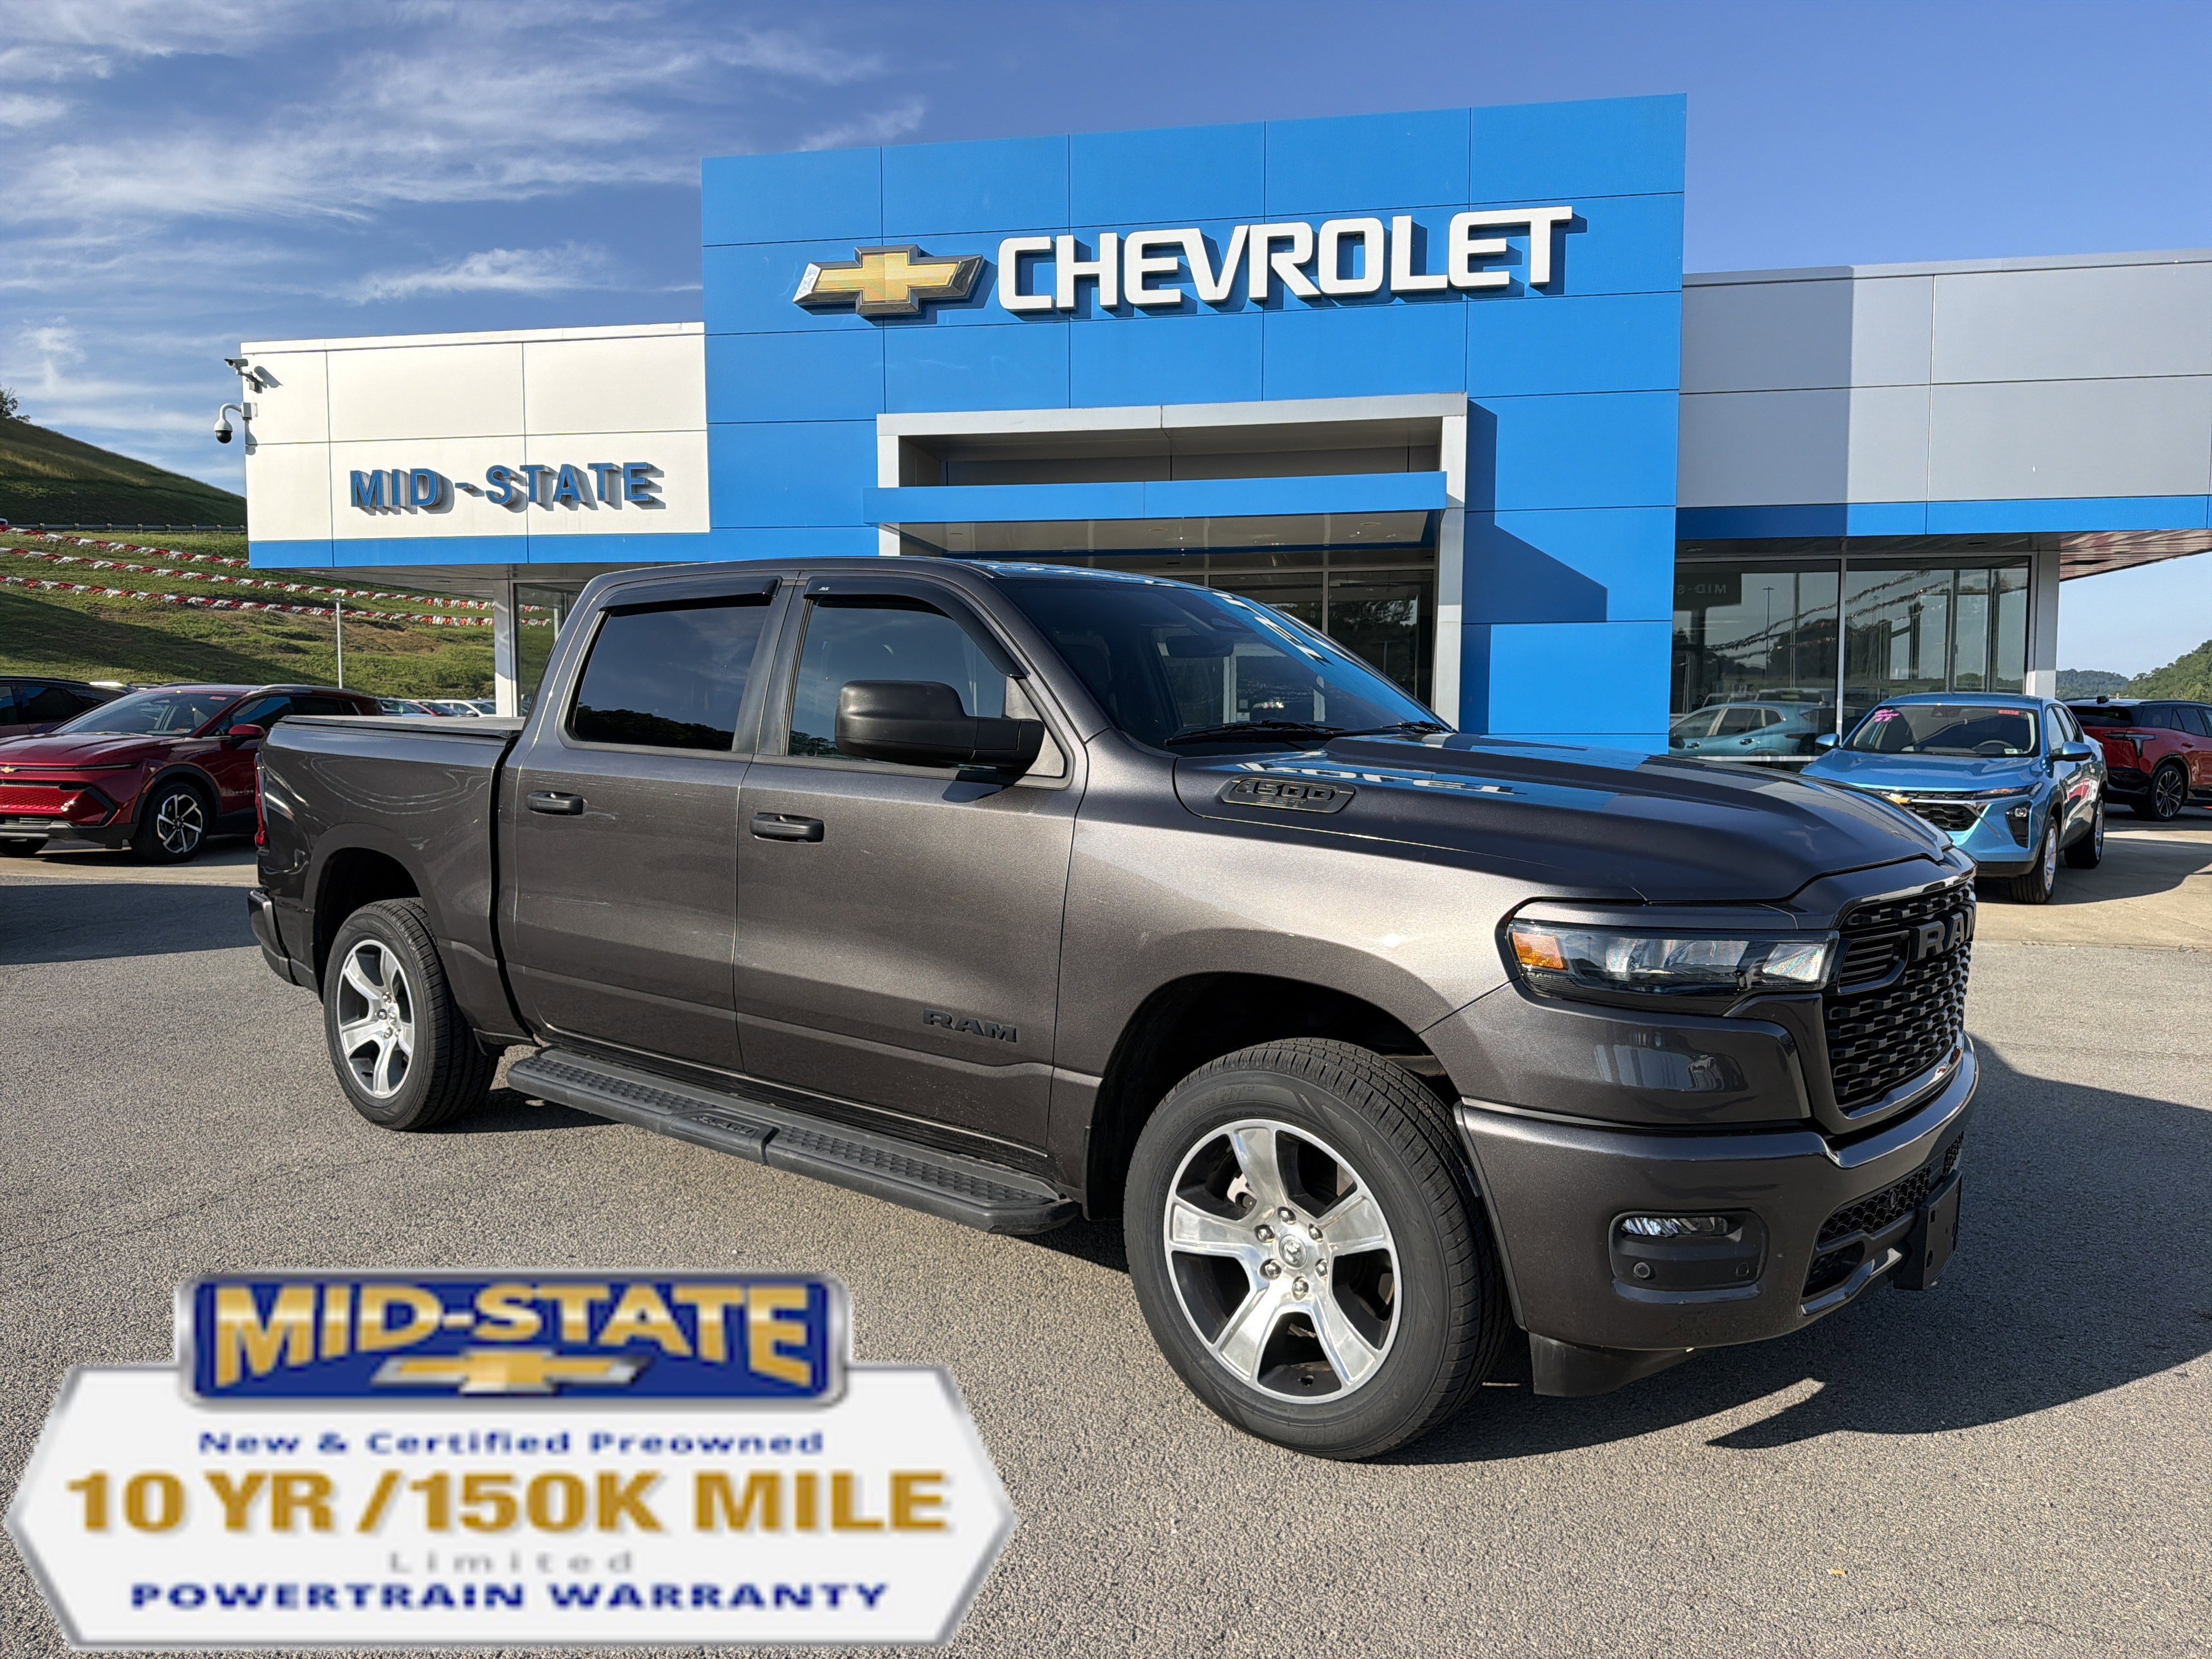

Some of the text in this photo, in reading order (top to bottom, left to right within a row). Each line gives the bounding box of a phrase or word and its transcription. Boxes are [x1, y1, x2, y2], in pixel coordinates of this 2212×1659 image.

[998, 206, 1572, 312] CHEVROLET
[350, 462, 654, 509] MID-STATE
[1245, 781, 1334, 801] 1500
[923, 1009, 1017, 1043] RAM
